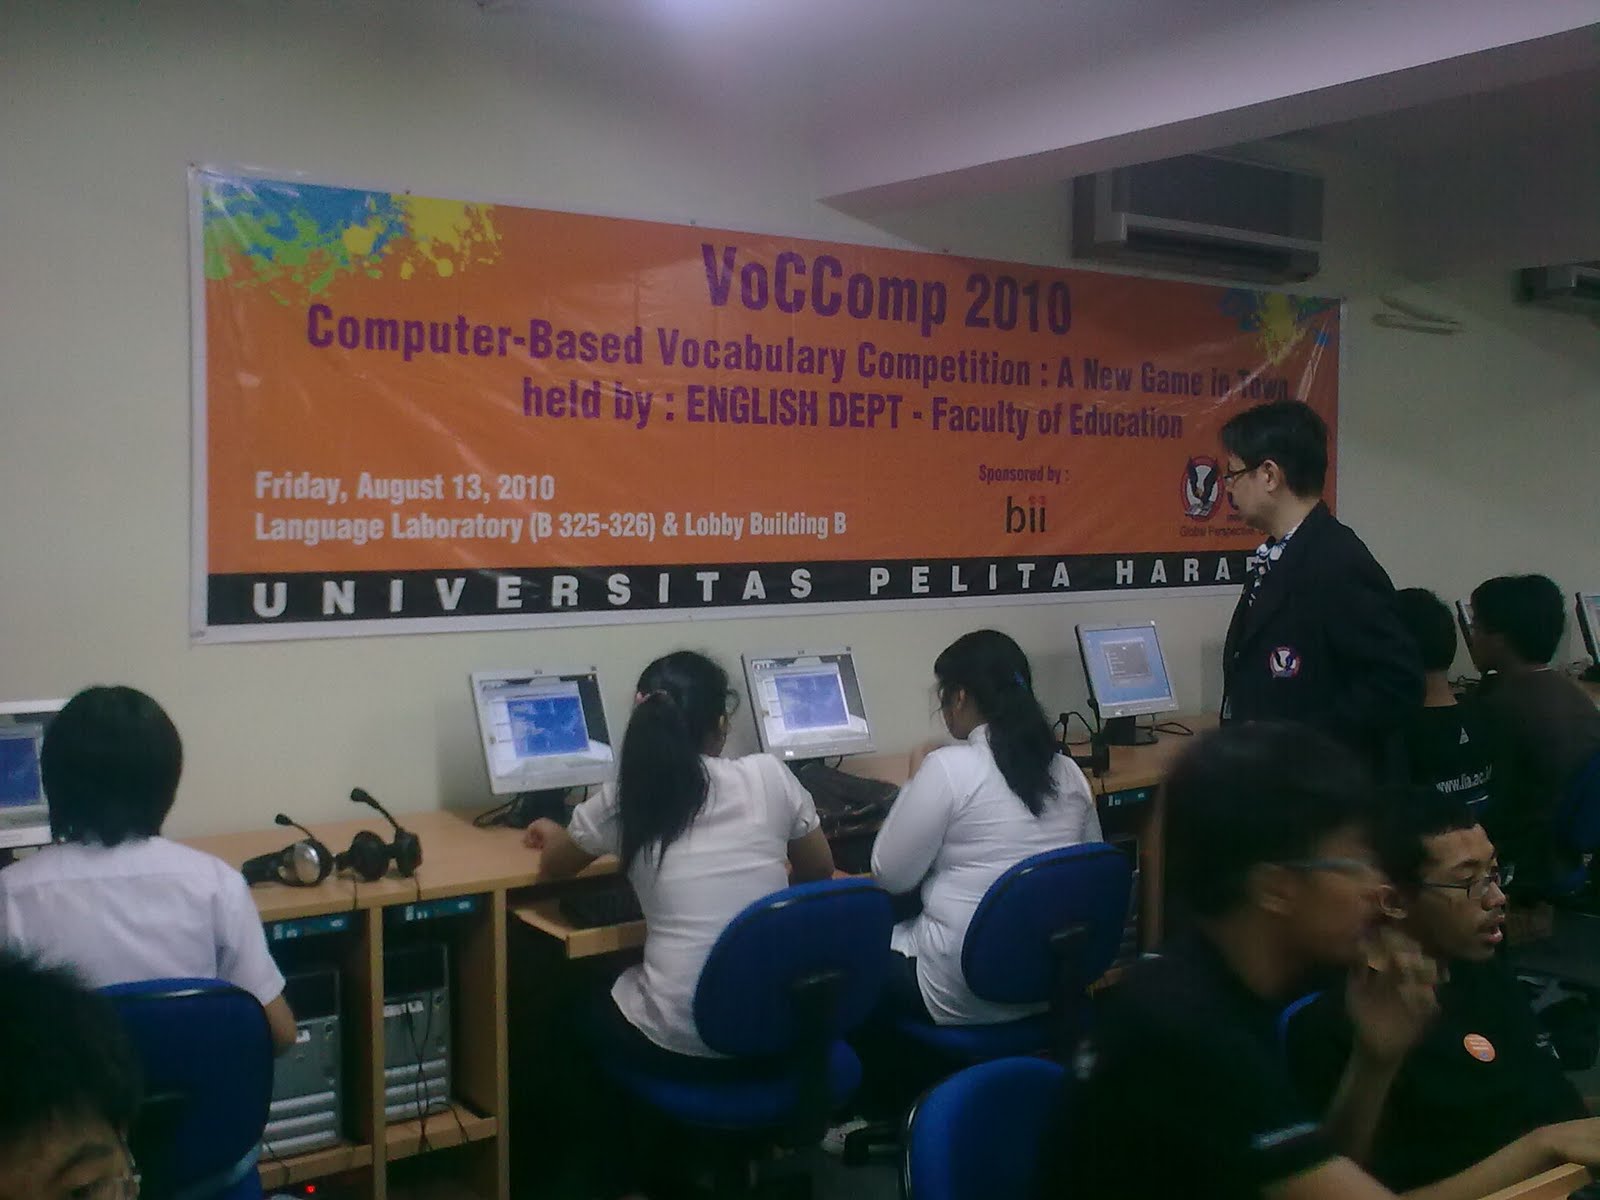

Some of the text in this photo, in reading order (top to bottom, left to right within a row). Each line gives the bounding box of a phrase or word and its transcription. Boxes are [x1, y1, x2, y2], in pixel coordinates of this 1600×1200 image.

[701, 243, 1071, 338] VoCComp 2010
[307, 303, 1288, 401] Computer-Based Vocabulary Competition : A New Game in Town
[523, 377, 601, 418] held
[615, 381, 654, 430] by
[666, 393, 674, 421] :
[687, 384, 818, 427] ENGLISH
[829, 390, 902, 429] DEPT
[932, 397, 1028, 441] Faculty
[1038, 402, 1064, 436] of
[1070, 403, 1183, 439] Education
[255, 471, 555, 505] Friday, August 13, 2010
[979, 463, 1043, 485] Sponsored
[1047, 464, 1062, 485] by
[255, 510, 847, 546] Language Laboratory (B 325-326) & Lobby Building B
[1006, 496, 1046, 534] bii
[252, 568, 812, 618] UNIVERSITAS
[869, 562, 1071, 595] PELITA
